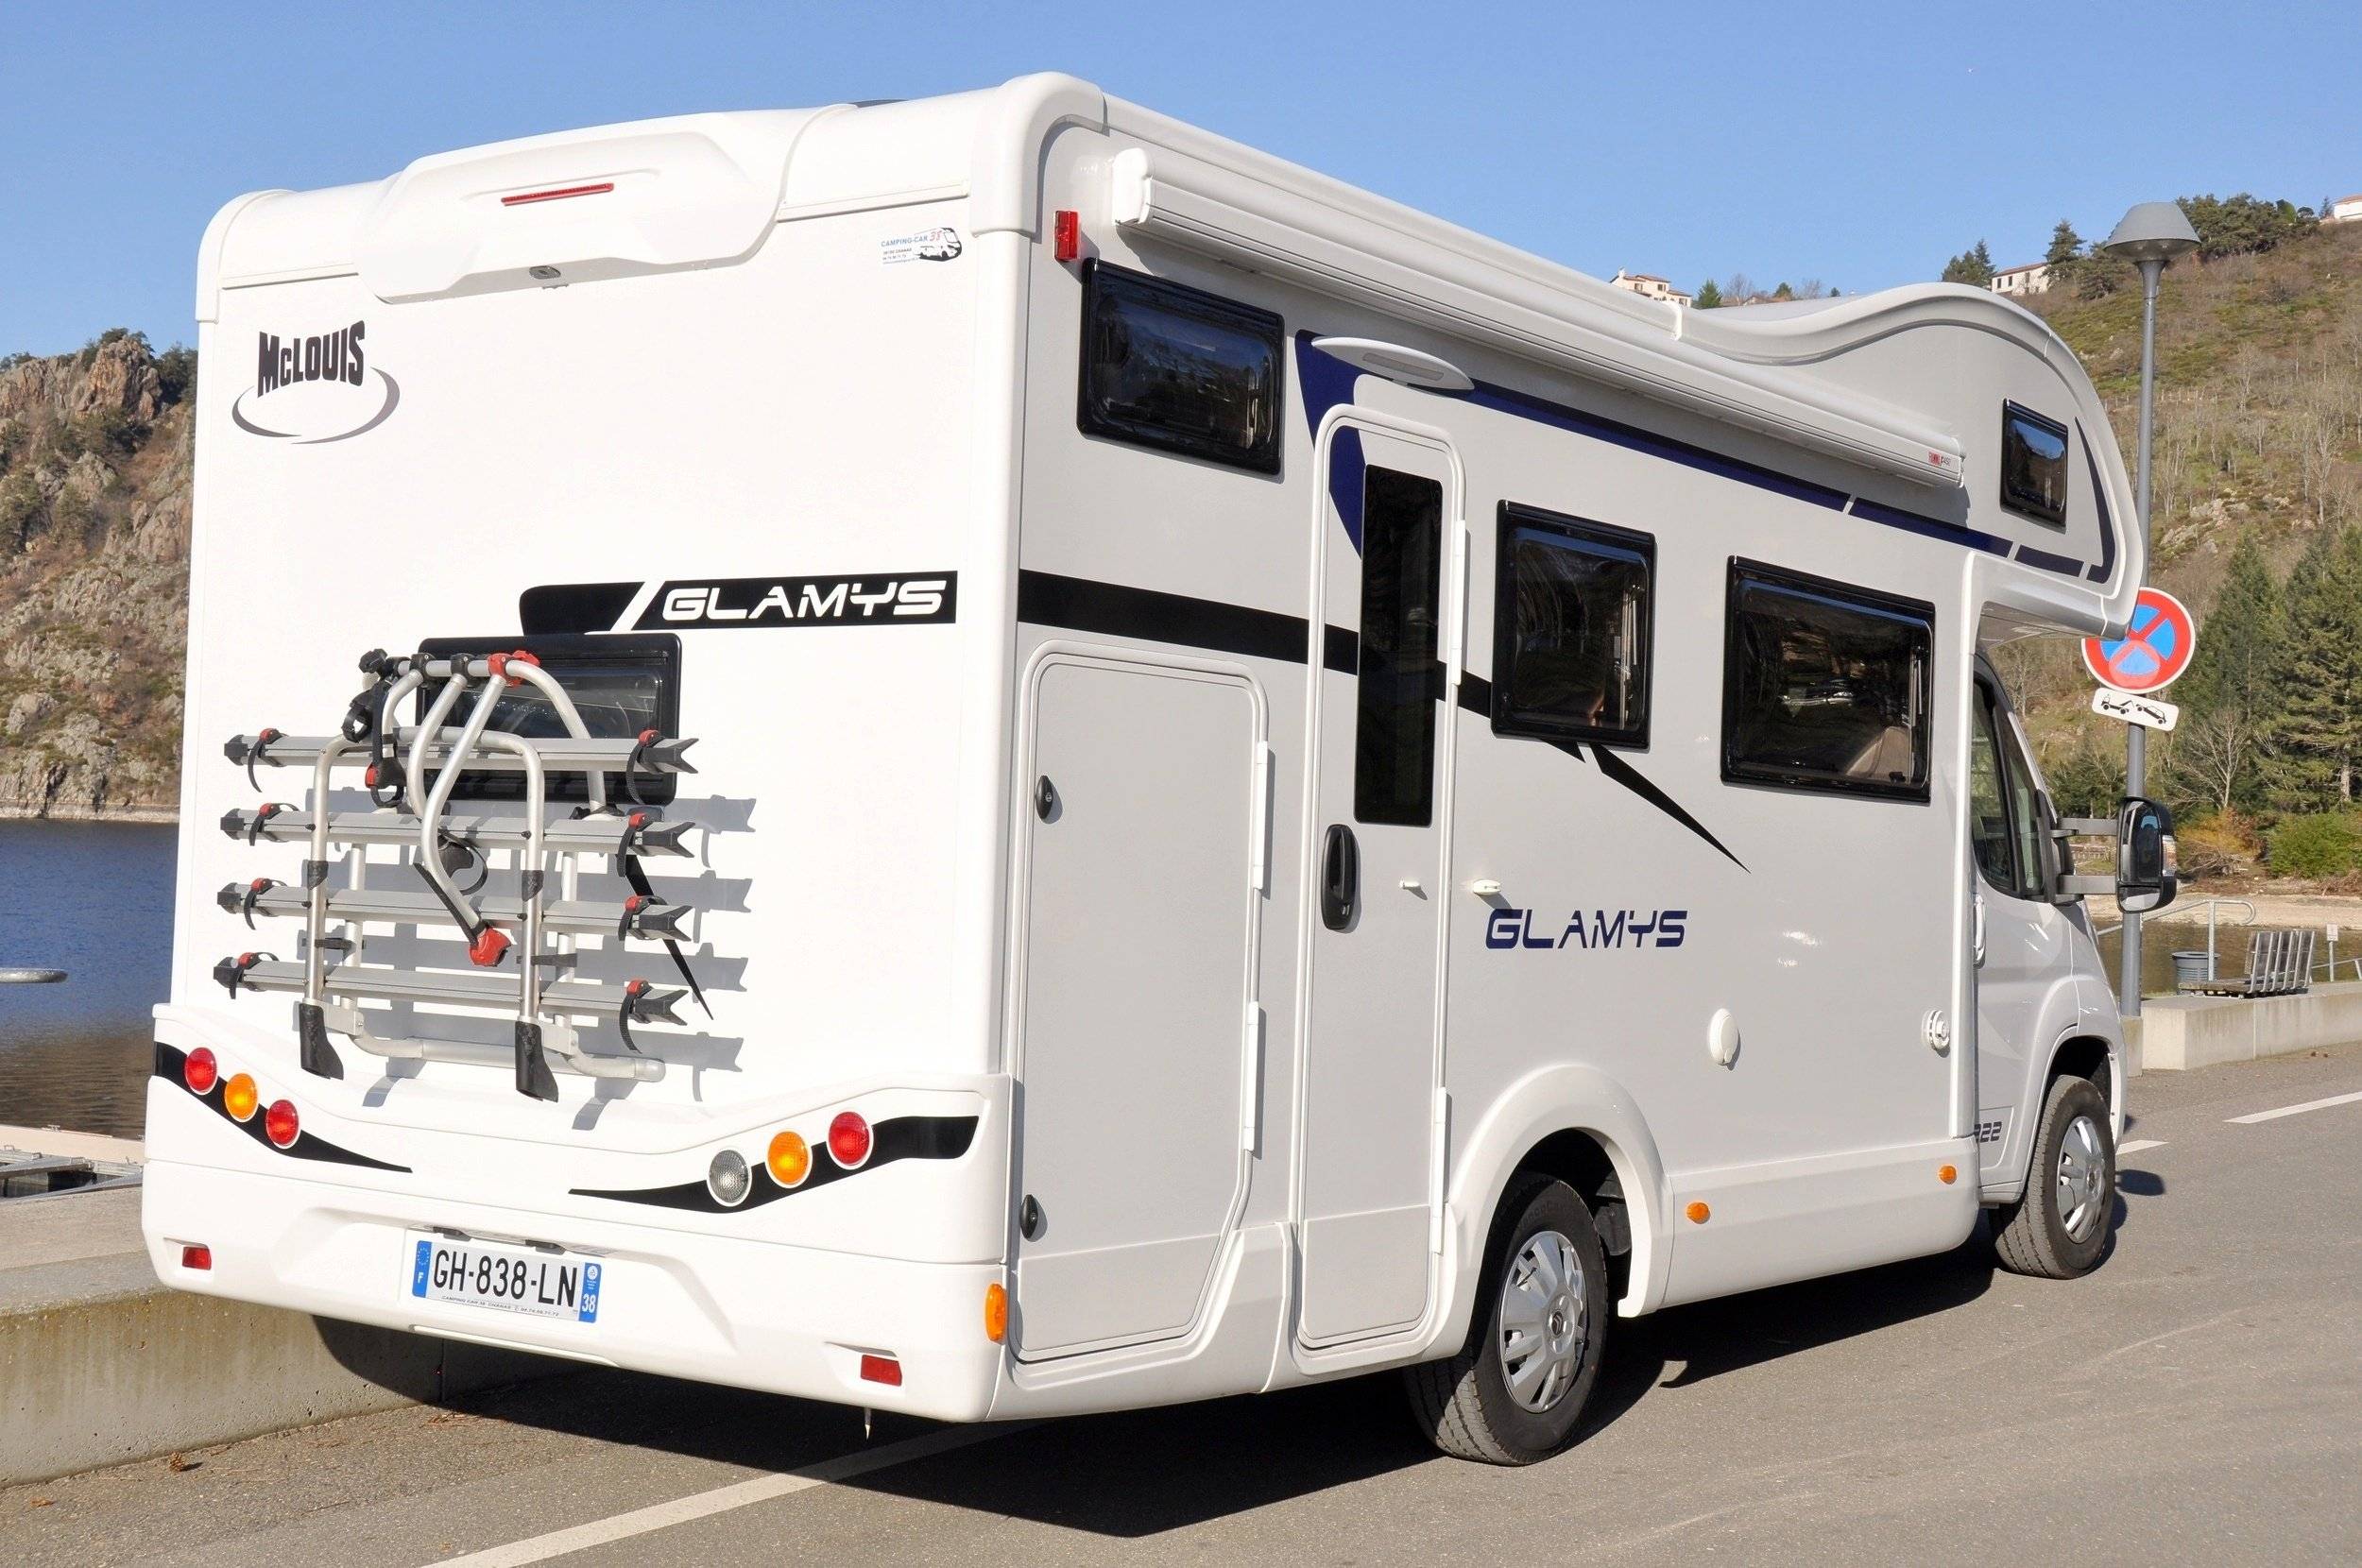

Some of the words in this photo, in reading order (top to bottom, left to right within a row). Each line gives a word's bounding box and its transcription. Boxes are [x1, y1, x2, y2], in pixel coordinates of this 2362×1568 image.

[662, 580, 947, 621] GLAMYS
[1485, 909, 1688, 949] GLAMYS
[418, 1271, 424, 1284] F
[433, 1250, 578, 1307] GH-838-LN
[581, 1293, 596, 1313] 38
